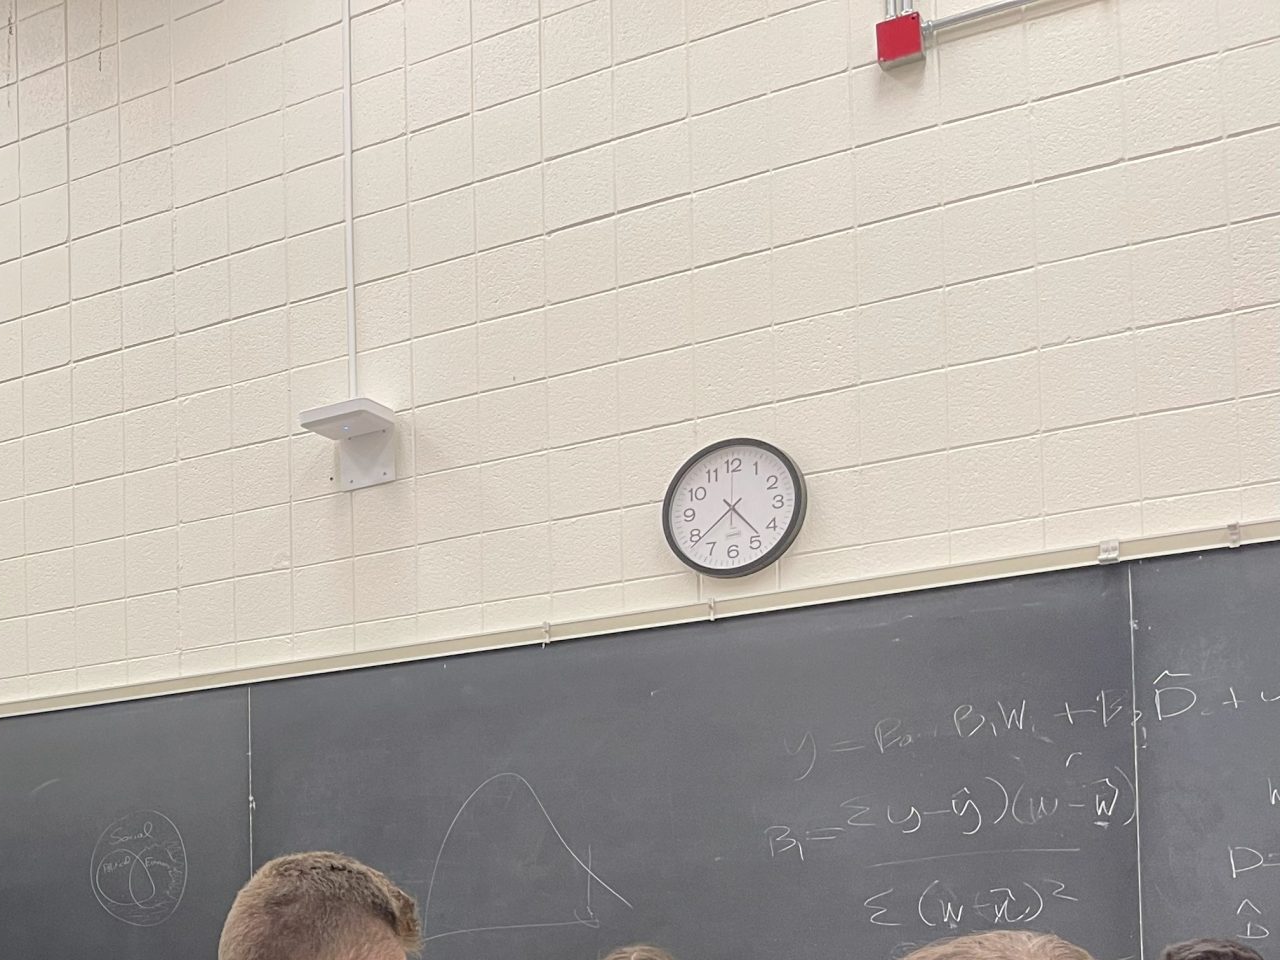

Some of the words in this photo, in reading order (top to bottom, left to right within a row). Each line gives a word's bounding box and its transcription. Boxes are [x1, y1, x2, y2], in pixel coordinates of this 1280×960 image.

[724, 458, 742, 473] 12
[753, 461, 758, 475] 1
[706, 468, 718, 483] 11
[766, 475, 778, 490] 2
[688, 486, 707, 501] 10
[772, 494, 784, 509] 3
[683, 508, 696, 522] 9
[766, 517, 778, 531] 4
[689, 528, 702, 543] 8
[749, 535, 762, 550] 5
[706, 541, 717, 556] 7
[727, 544, 739, 559] 6
